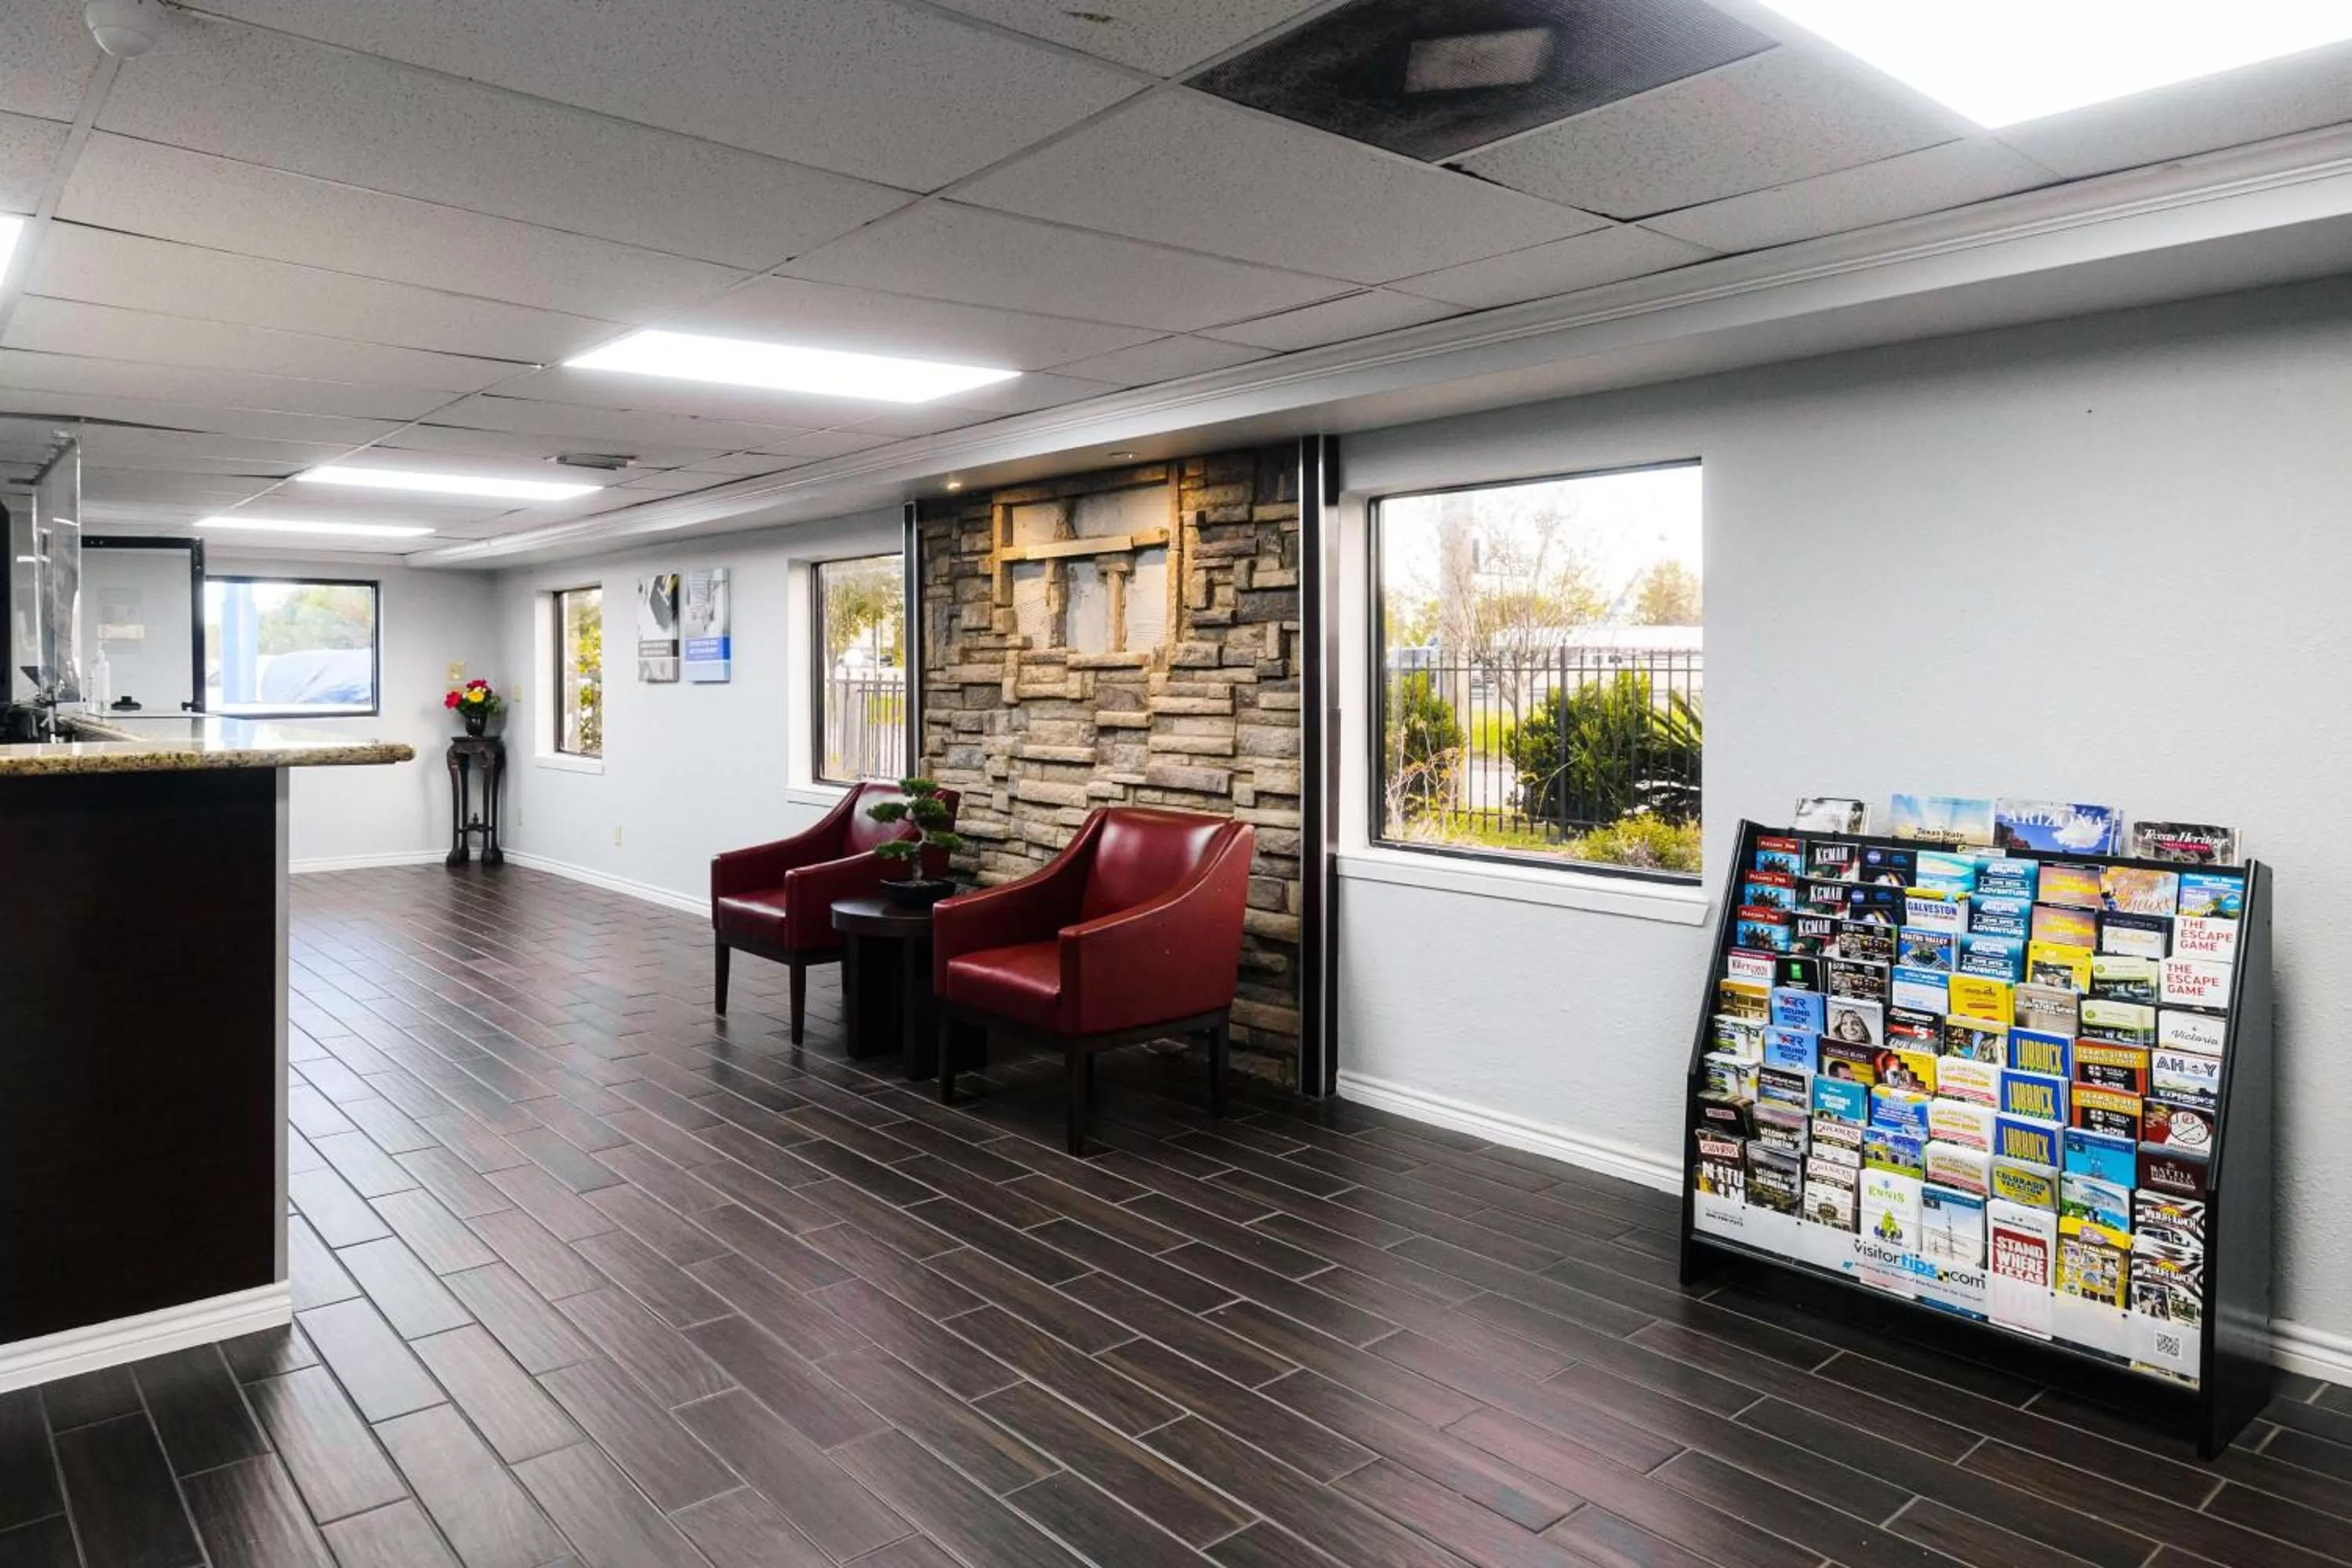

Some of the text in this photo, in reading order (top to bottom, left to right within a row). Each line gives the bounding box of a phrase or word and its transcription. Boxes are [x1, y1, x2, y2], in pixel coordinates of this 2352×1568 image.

[2144, 828, 2230, 850] Texas Heritage
[1978, 887, 2030, 897] ADVENTURE
[1907, 902, 1958, 916] GALVESTON
[2182, 918, 2206, 929] THE
[1972, 925, 2024, 935] ADVENTURE
[2180, 930, 2234, 942] ESCAPE
[2180, 941, 2218, 952] GAME
[1961, 966, 2014, 978] ADVENTURE
[2167, 963, 2193, 974] THE
[2166, 975, 2220, 987] ESCAPE
[2167, 985, 2205, 996] GAME
[1780, 1007, 1810, 1017] ROUND
[1784, 1014, 1807, 1024] ROCK
[2171, 1029, 2219, 1045] Victoria
[1776, 1045, 1807, 1055] ROUND
[1780, 1052, 1803, 1062] ROCK
[1995, 1171, 2045, 1191] COLORADO
[1867, 1185, 1906, 1203] ENNIS
[2002, 1180, 2042, 1196] VACATION
[1996, 1235, 2045, 1258] STAND
[1998, 1249, 2045, 1272] WHERE
[1996, 1263, 2045, 1286] TEXAS
